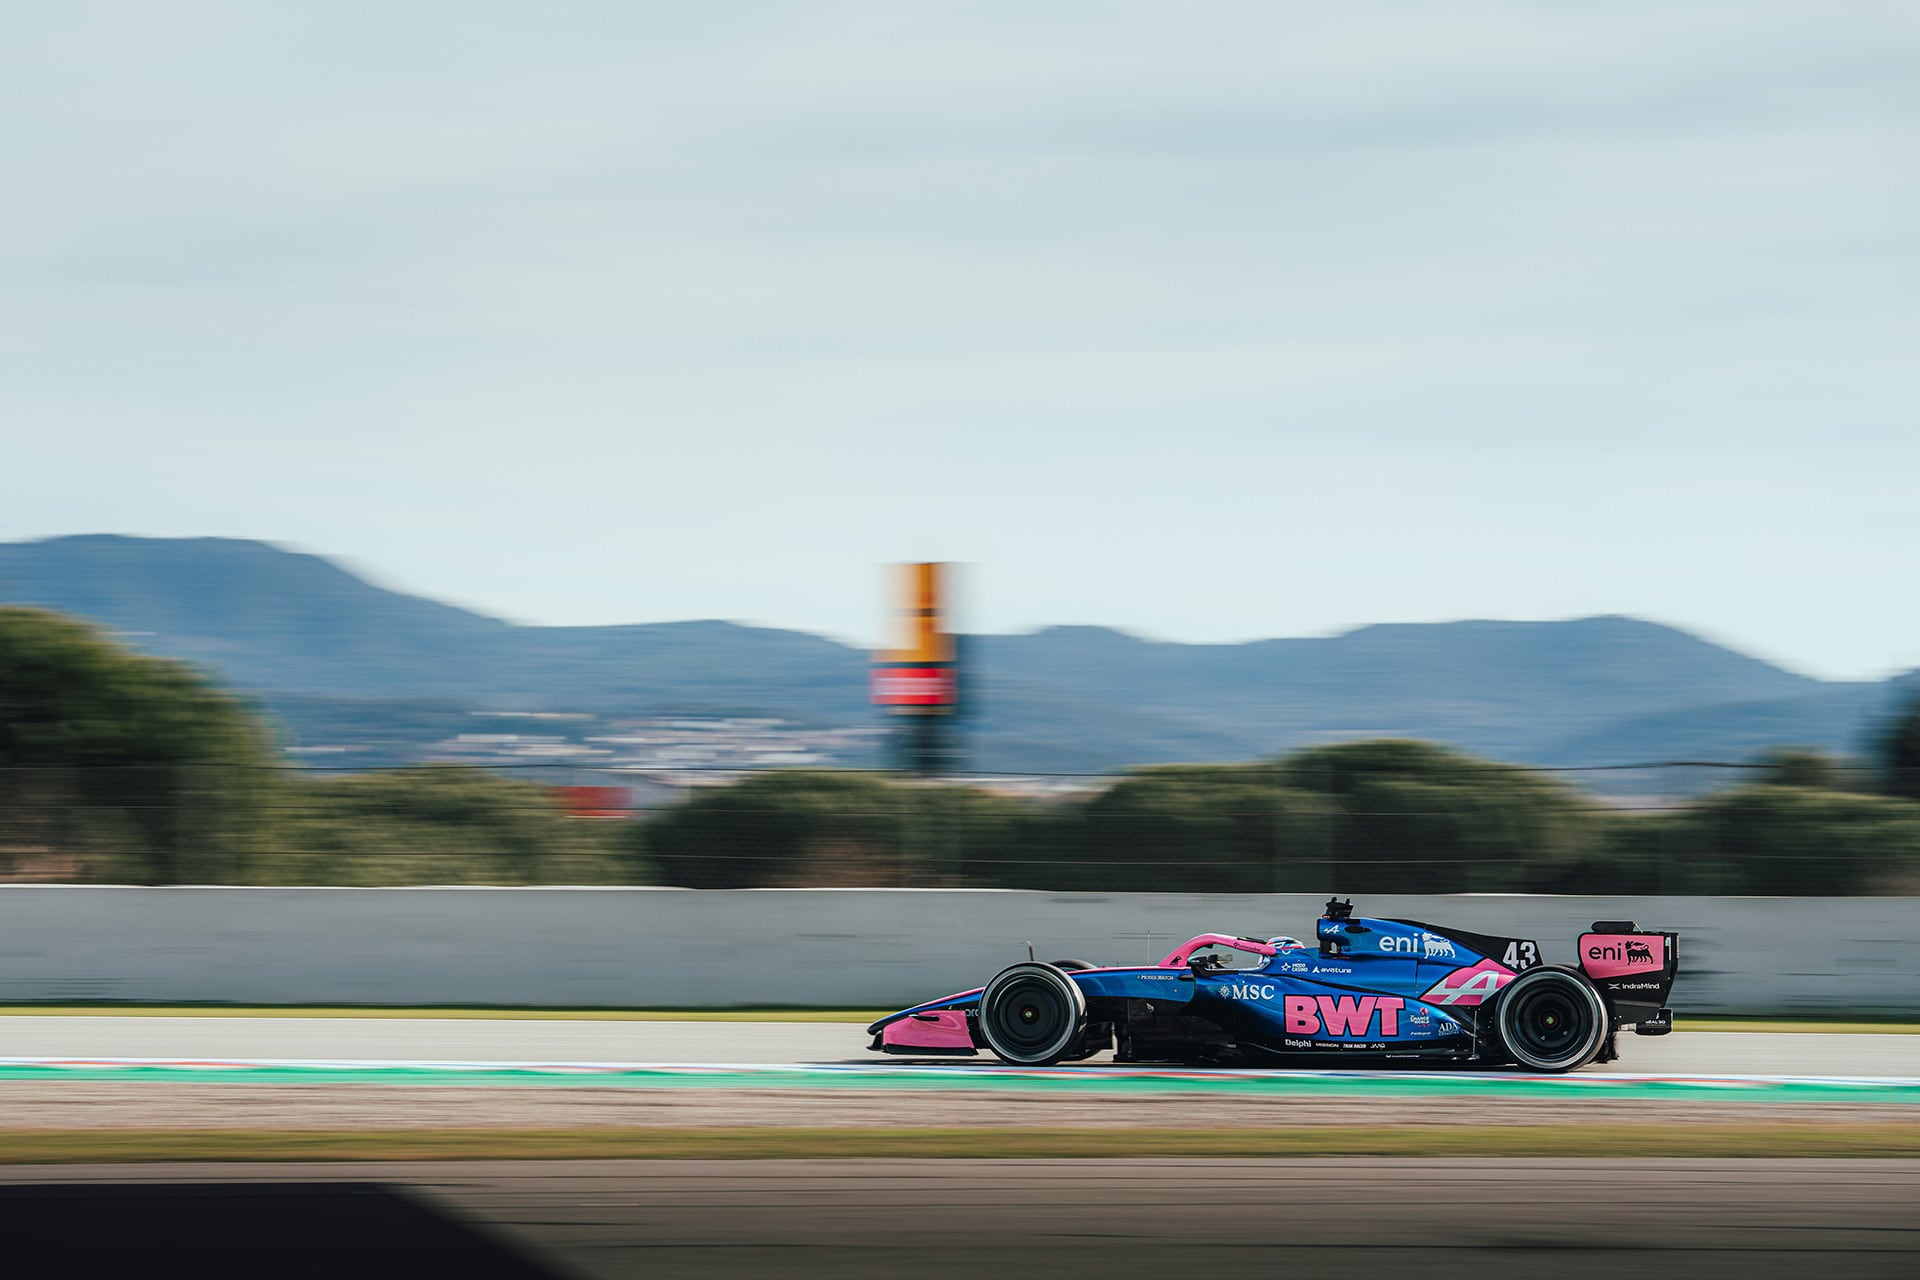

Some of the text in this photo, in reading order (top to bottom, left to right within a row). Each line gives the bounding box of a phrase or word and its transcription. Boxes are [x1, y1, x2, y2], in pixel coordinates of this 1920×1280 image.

[1379, 932, 1419, 953] eni
[1588, 942, 1622, 961] eni
[1502, 940, 1537, 970] 43
[1231, 984, 1275, 1000] MSC
[1621, 982, 1661, 990] IndraMind
[1284, 995, 1405, 1037] BWT
[1284, 1038, 1312, 1049] Delphi
